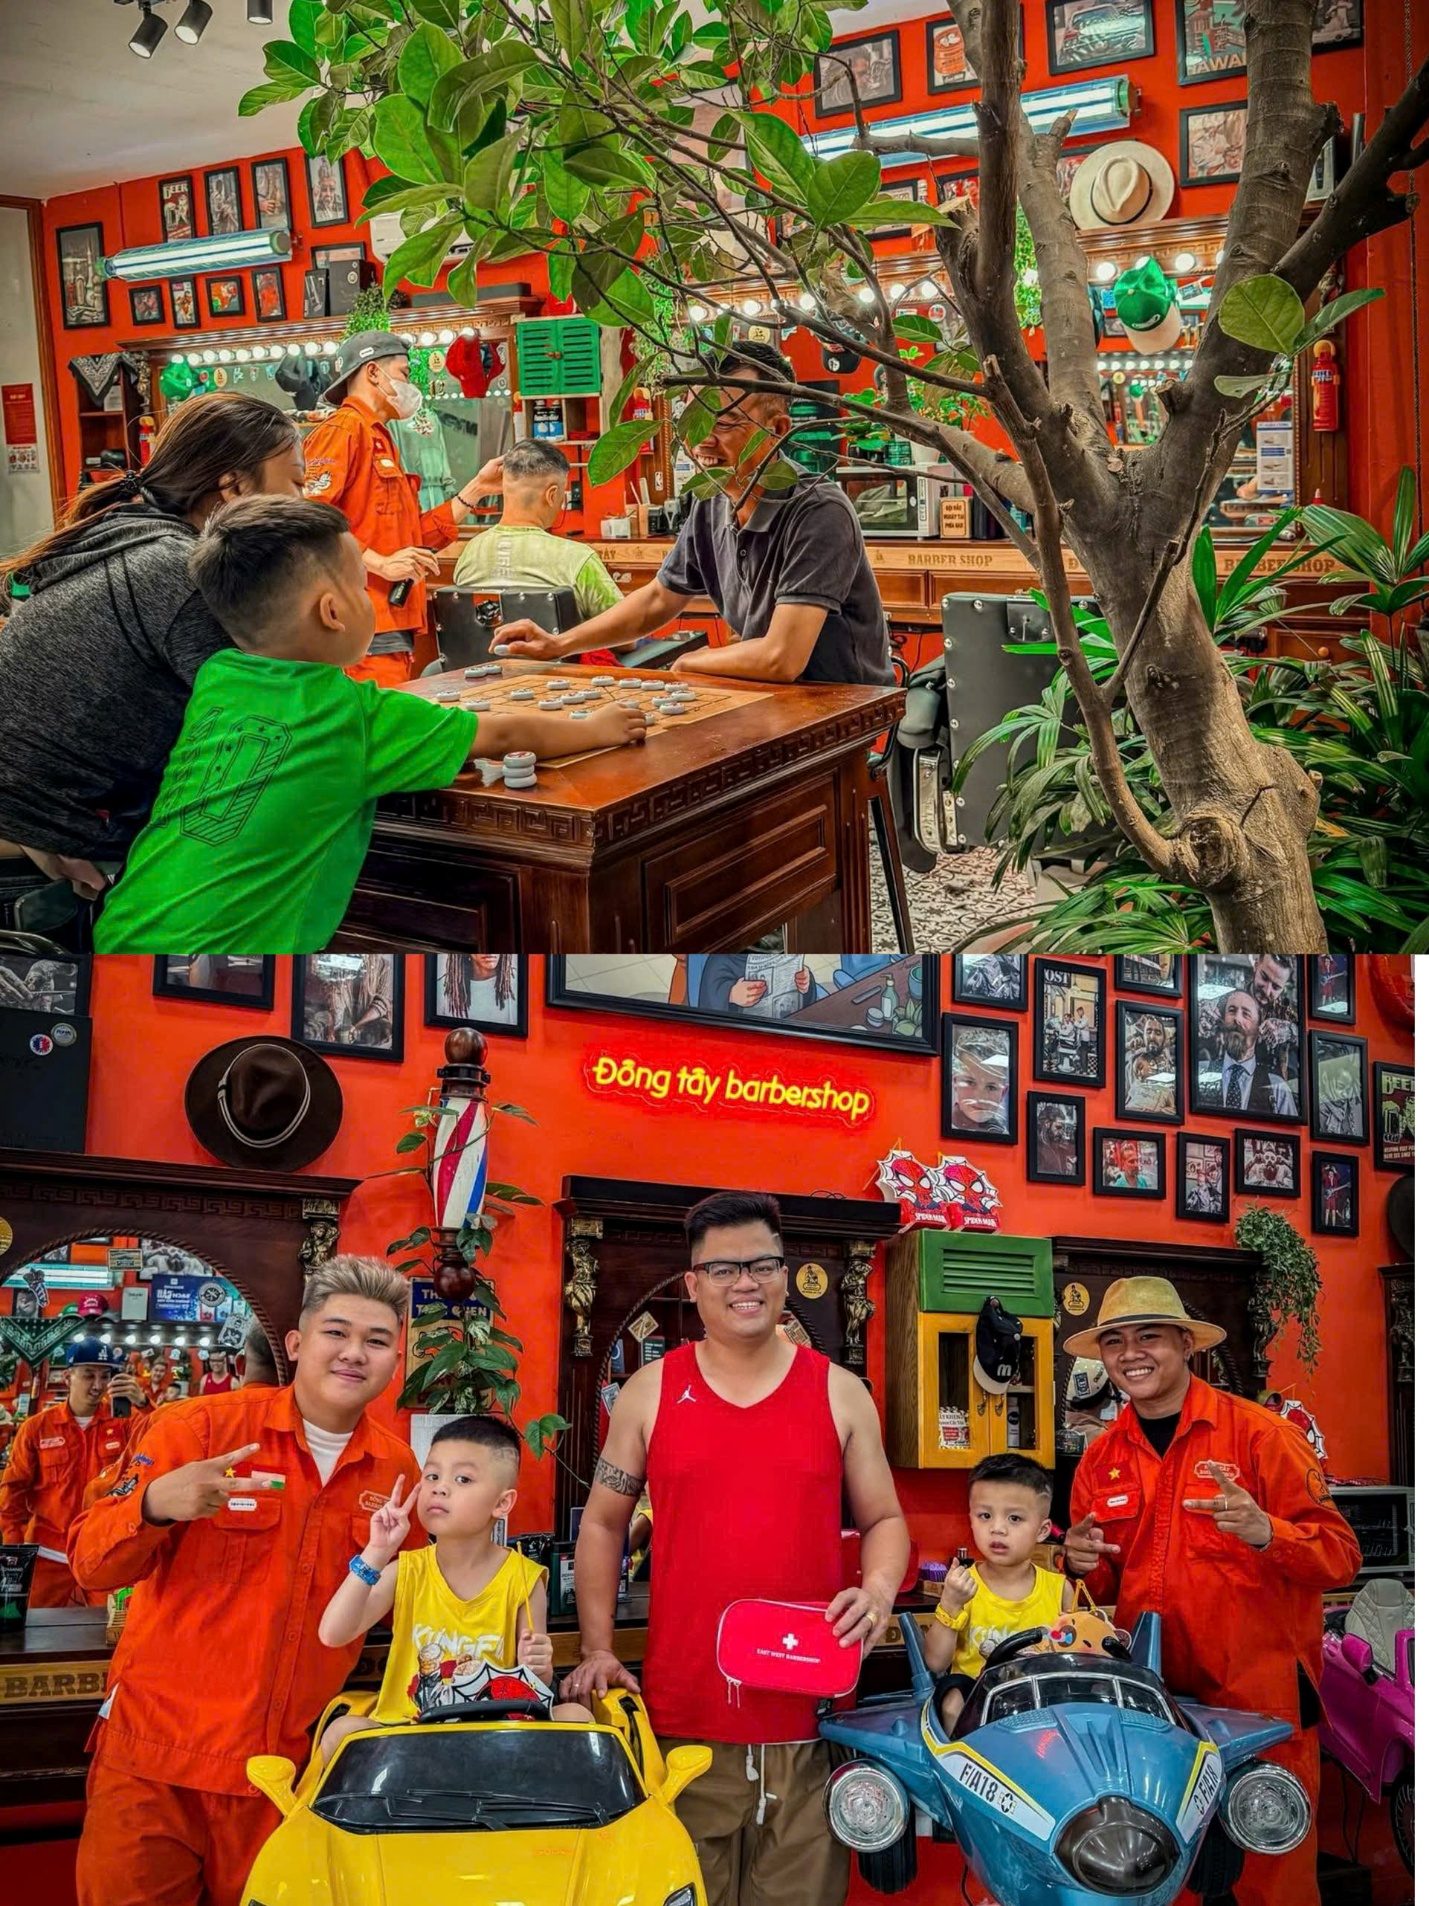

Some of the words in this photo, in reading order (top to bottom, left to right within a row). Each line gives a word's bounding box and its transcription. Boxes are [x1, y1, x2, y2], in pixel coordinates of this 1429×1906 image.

[163, 183, 188, 200] BEER
[908, 555, 957, 567] BARBER
[959, 555, 993, 567] SHOP
[677, 1065, 720, 1105] tây
[725, 1069, 870, 1121] barbershop
[756, 1648, 770, 1656] EAST
[770, 1651, 785, 1659] WEST
[785, 1654, 821, 1664] BARBERSHOP
[960, 1762, 998, 1803] F/A18
[1198, 1763, 1219, 1805] F/A18
